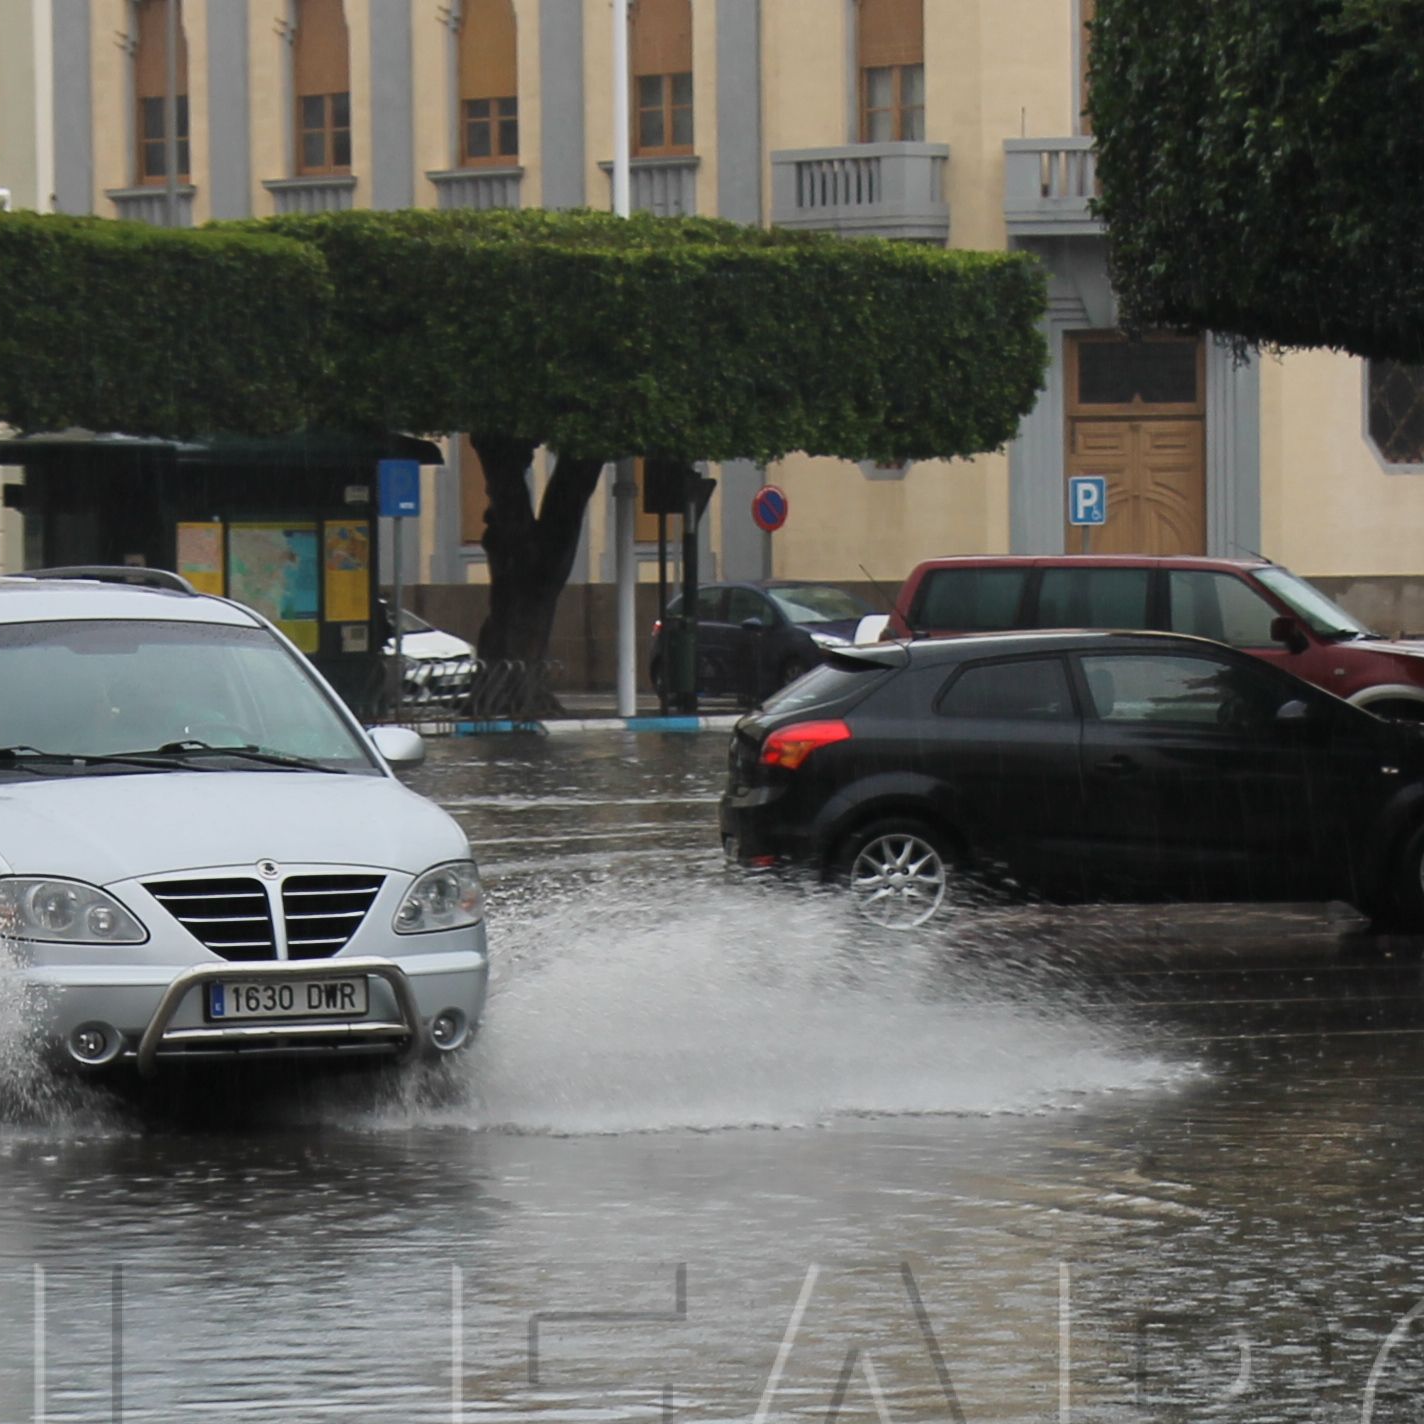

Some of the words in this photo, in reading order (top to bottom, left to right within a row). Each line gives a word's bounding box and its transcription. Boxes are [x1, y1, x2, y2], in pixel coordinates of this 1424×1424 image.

[1077, 483, 1098, 519] P
[232, 984, 294, 1012] 1630
[307, 982, 356, 1010] DWR
